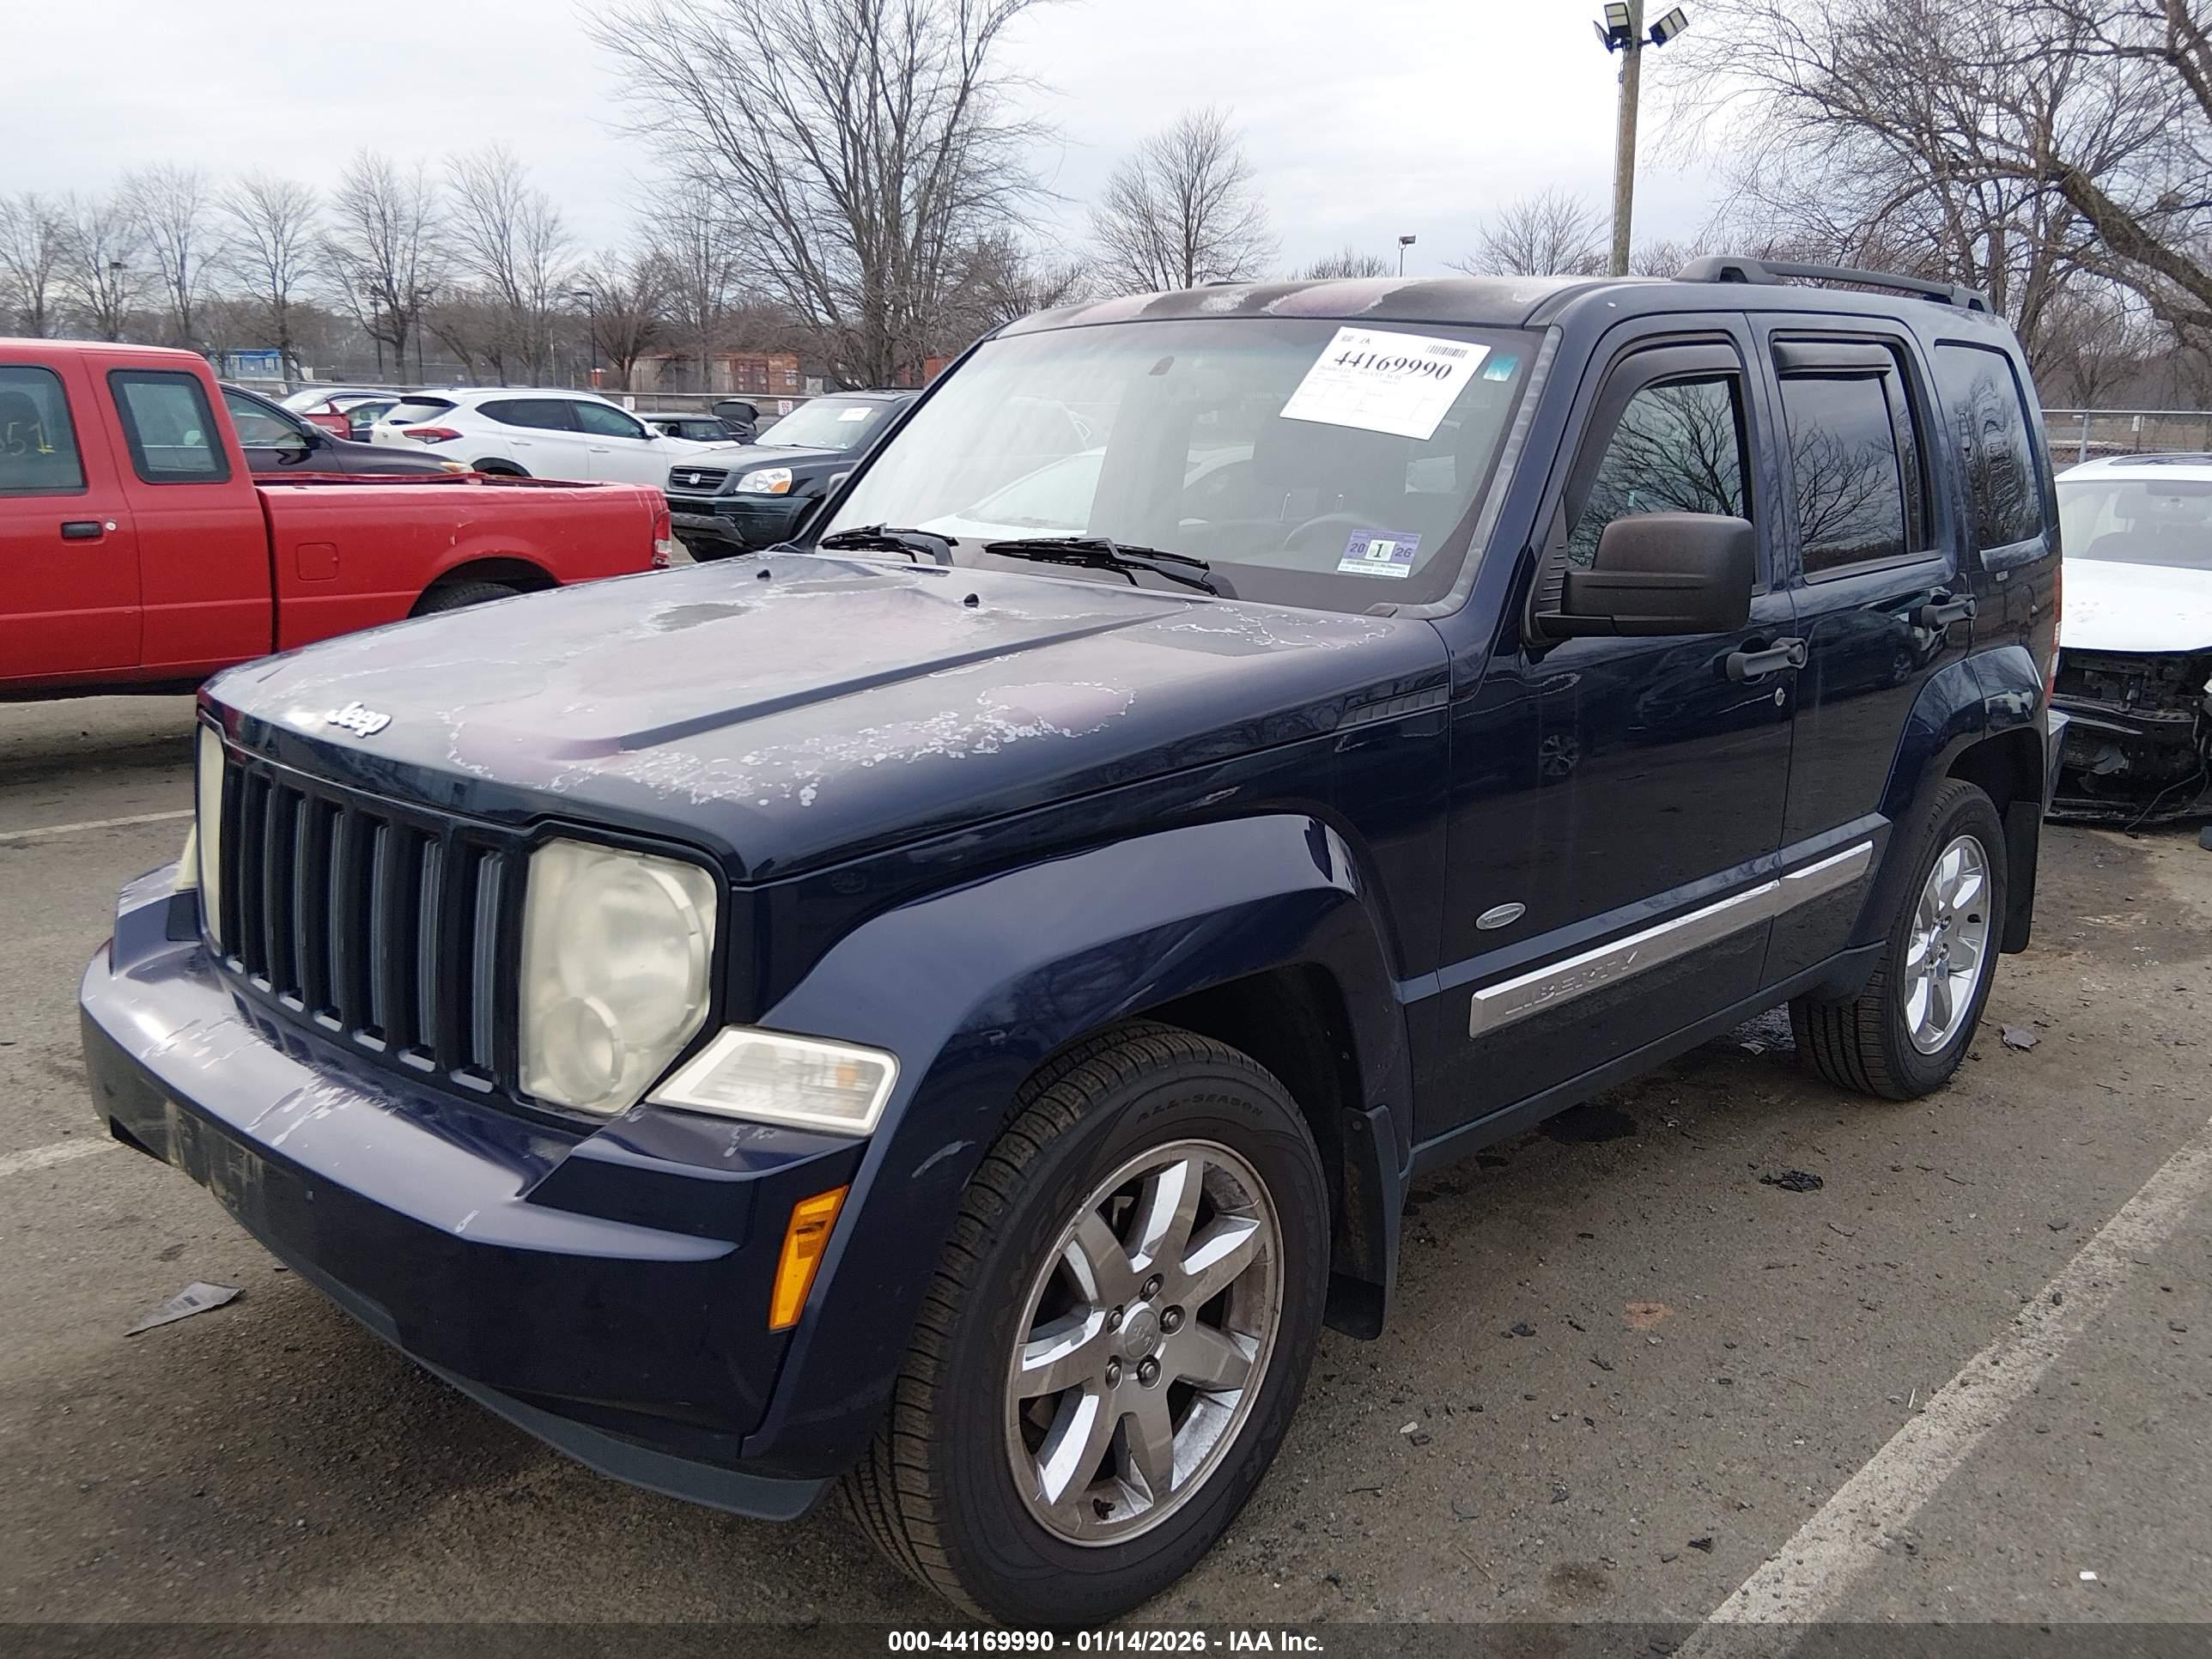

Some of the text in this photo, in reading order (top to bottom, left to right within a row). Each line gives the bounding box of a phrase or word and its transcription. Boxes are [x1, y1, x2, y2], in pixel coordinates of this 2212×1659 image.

[1334, 350, 1453, 380] 44169990
[1349, 542, 1413, 558] 20 1 26
[324, 701, 392, 738] Jeep
